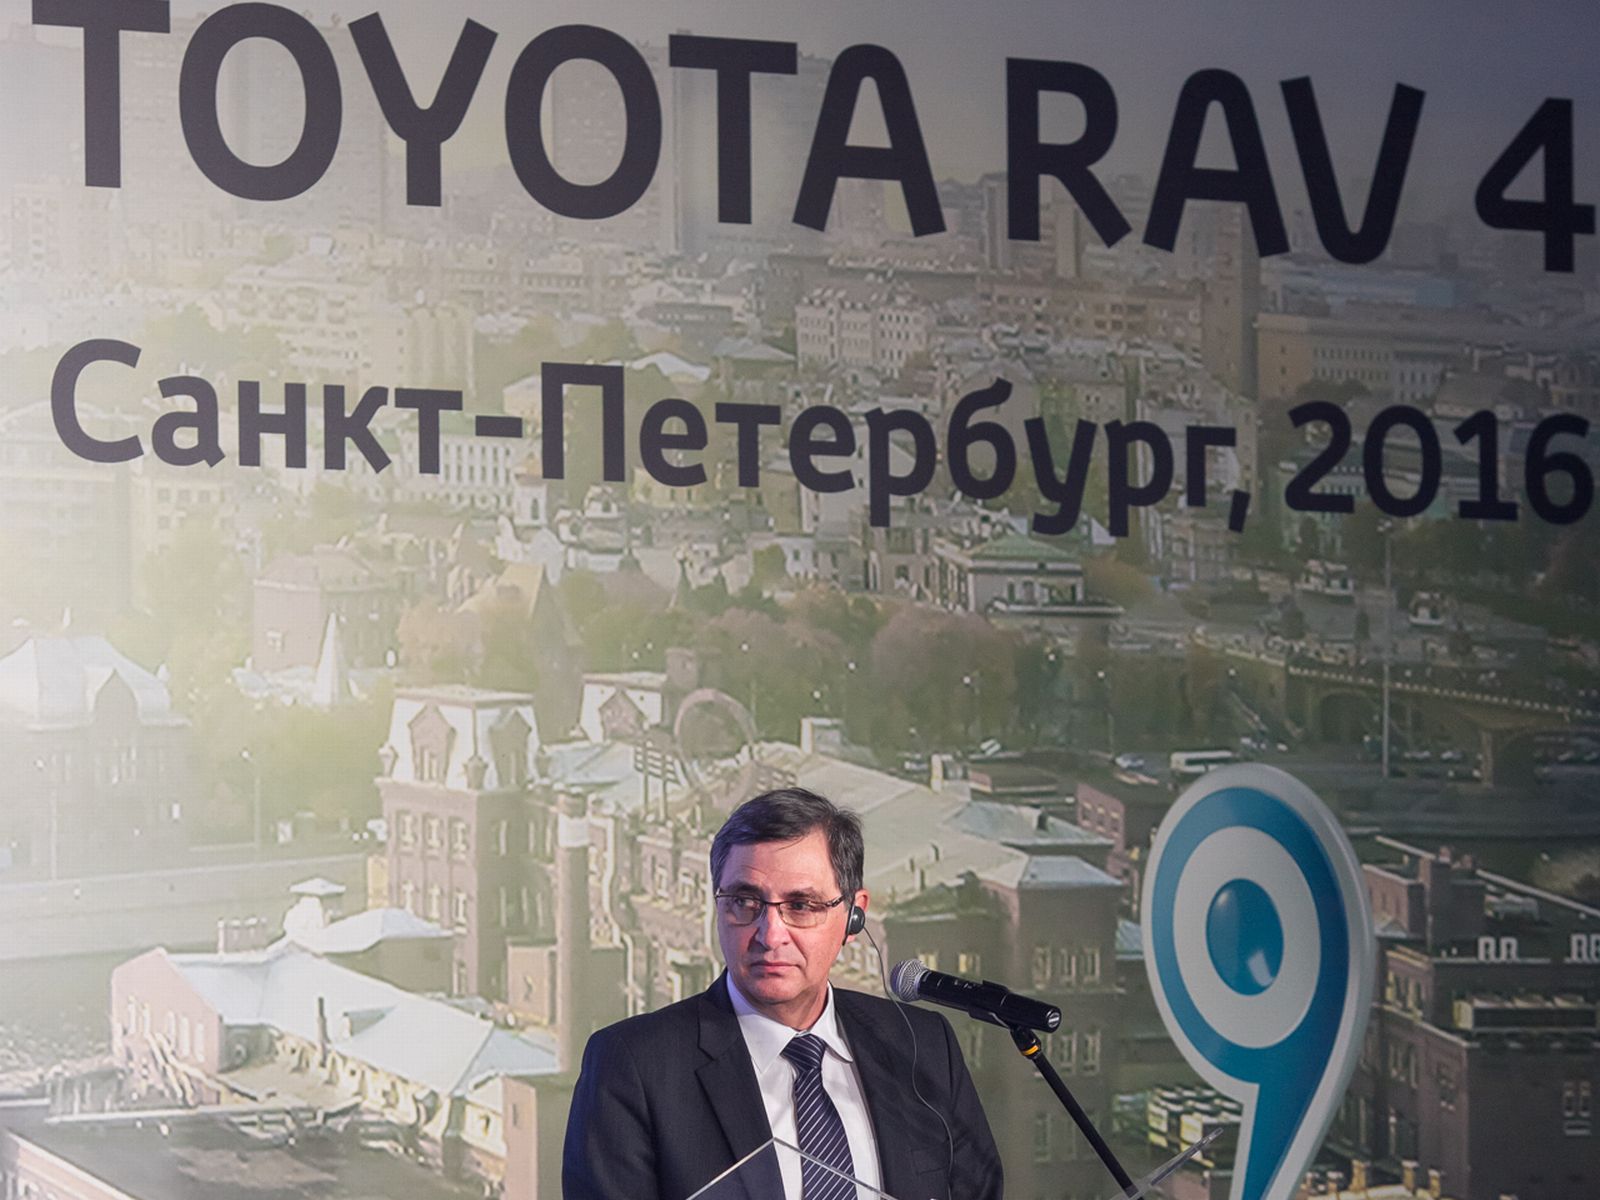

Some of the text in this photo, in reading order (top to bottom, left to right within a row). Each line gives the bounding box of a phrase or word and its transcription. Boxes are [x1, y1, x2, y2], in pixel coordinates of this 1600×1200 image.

[32, 0, 1596, 273] TOYOTA RAV 4
[50, 338, 1595, 537] Санкт-Петербург, 2016
